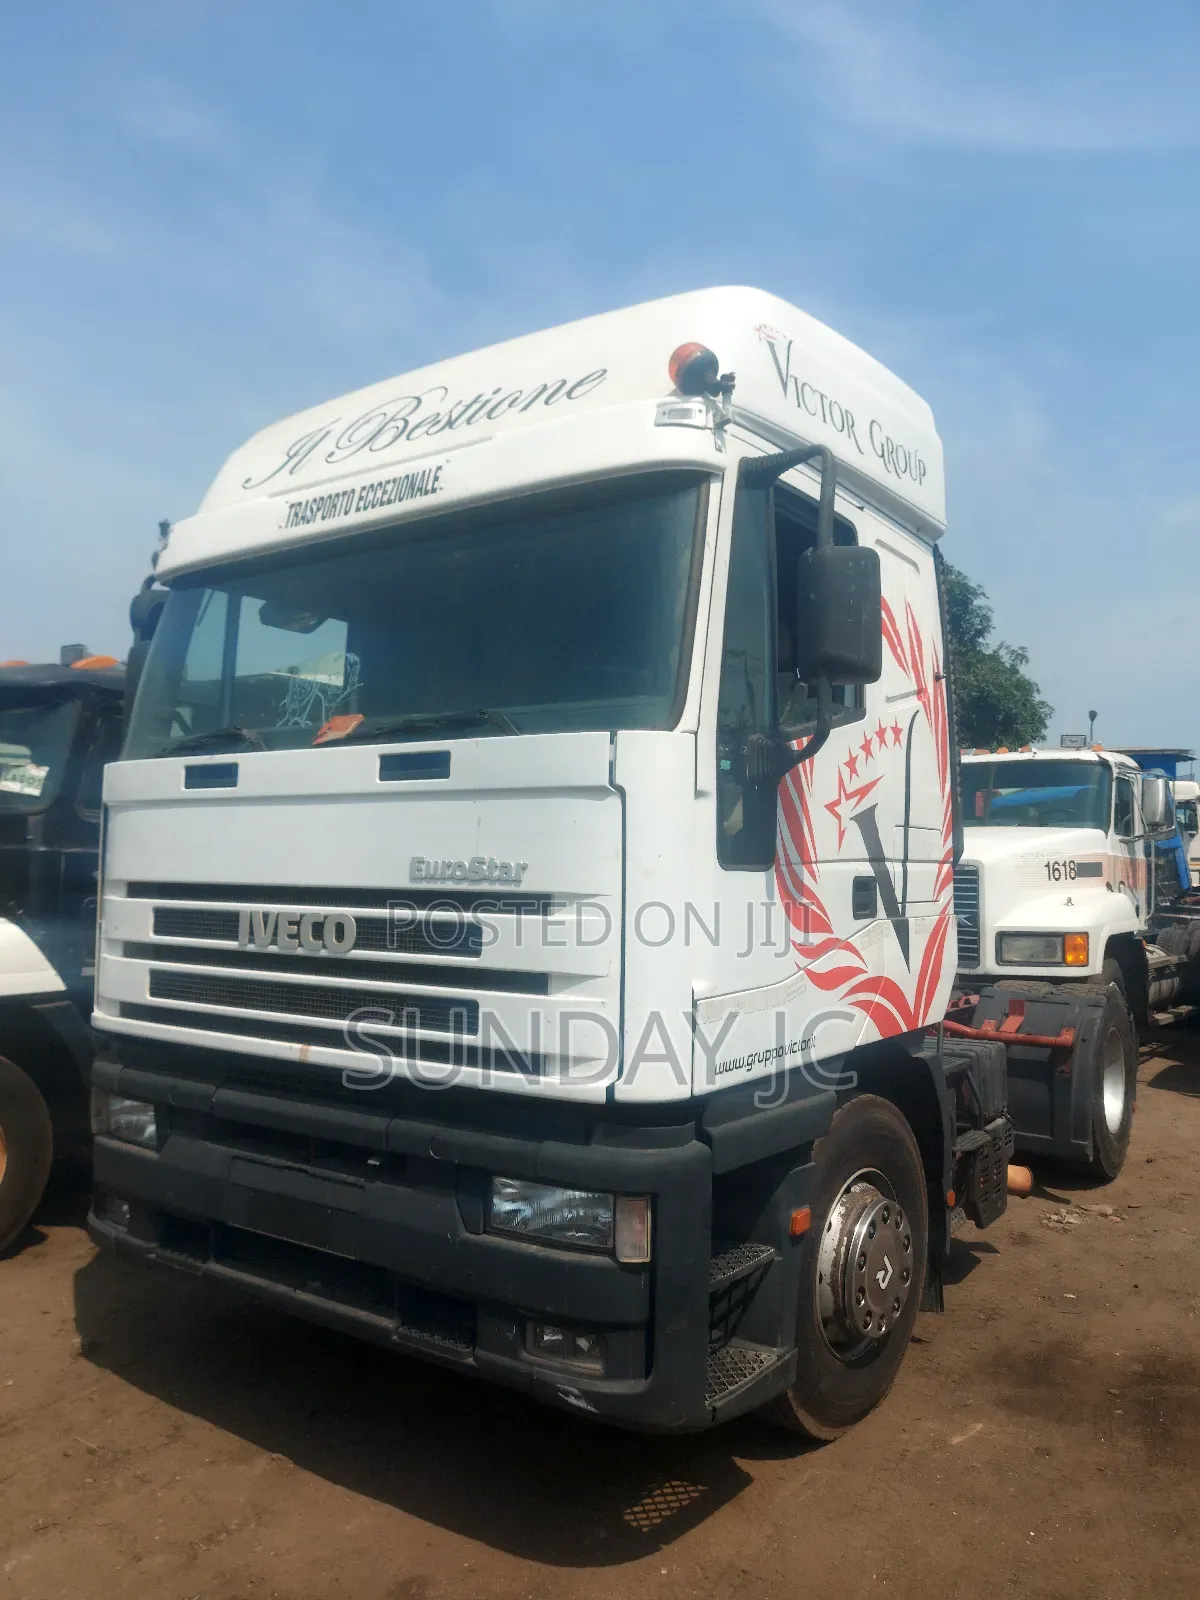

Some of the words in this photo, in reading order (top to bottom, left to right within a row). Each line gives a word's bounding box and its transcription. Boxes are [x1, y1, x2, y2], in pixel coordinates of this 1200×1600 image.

[324, 367, 609, 464] Bestione
[766, 339, 865, 455] VICTOR
[868, 419, 927, 486] GROUP
[284, 487, 356, 529] TRASPORTO
[354, 464, 443, 513] ECCEZIONALE
[408, 855, 529, 887] EuroStar
[1044, 859, 1077, 882] 1618
[237, 909, 357, 954] IVECO
